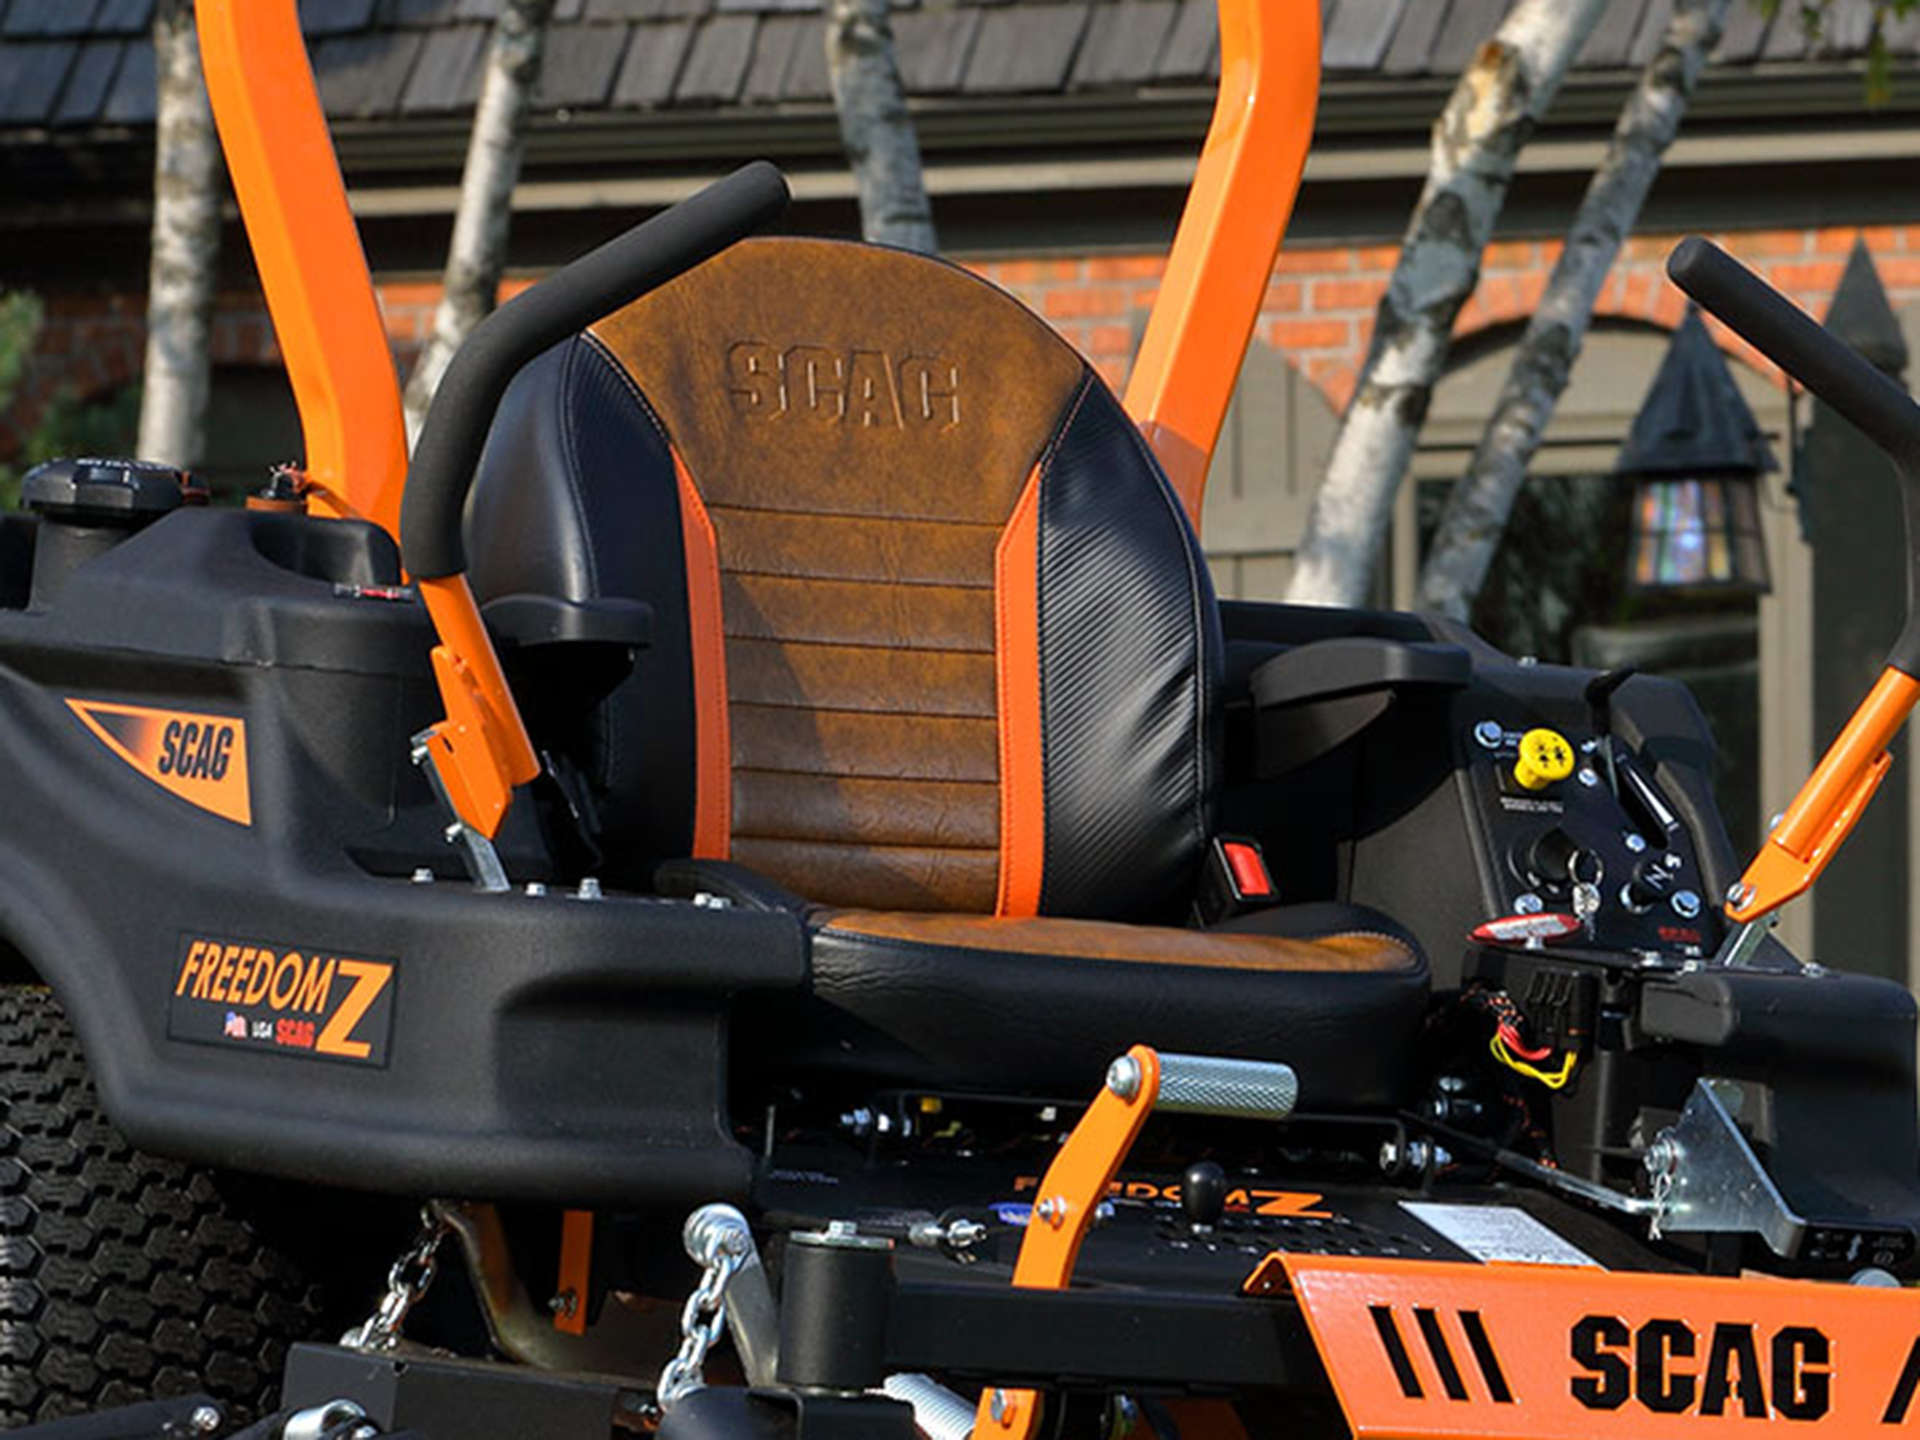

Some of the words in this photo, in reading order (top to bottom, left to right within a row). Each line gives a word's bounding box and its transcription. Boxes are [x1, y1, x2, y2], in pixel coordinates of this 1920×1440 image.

[727, 339, 959, 432] SCAG
[158, 719, 234, 781] SCAG
[1570, 1314, 1831, 1422] SCAG
